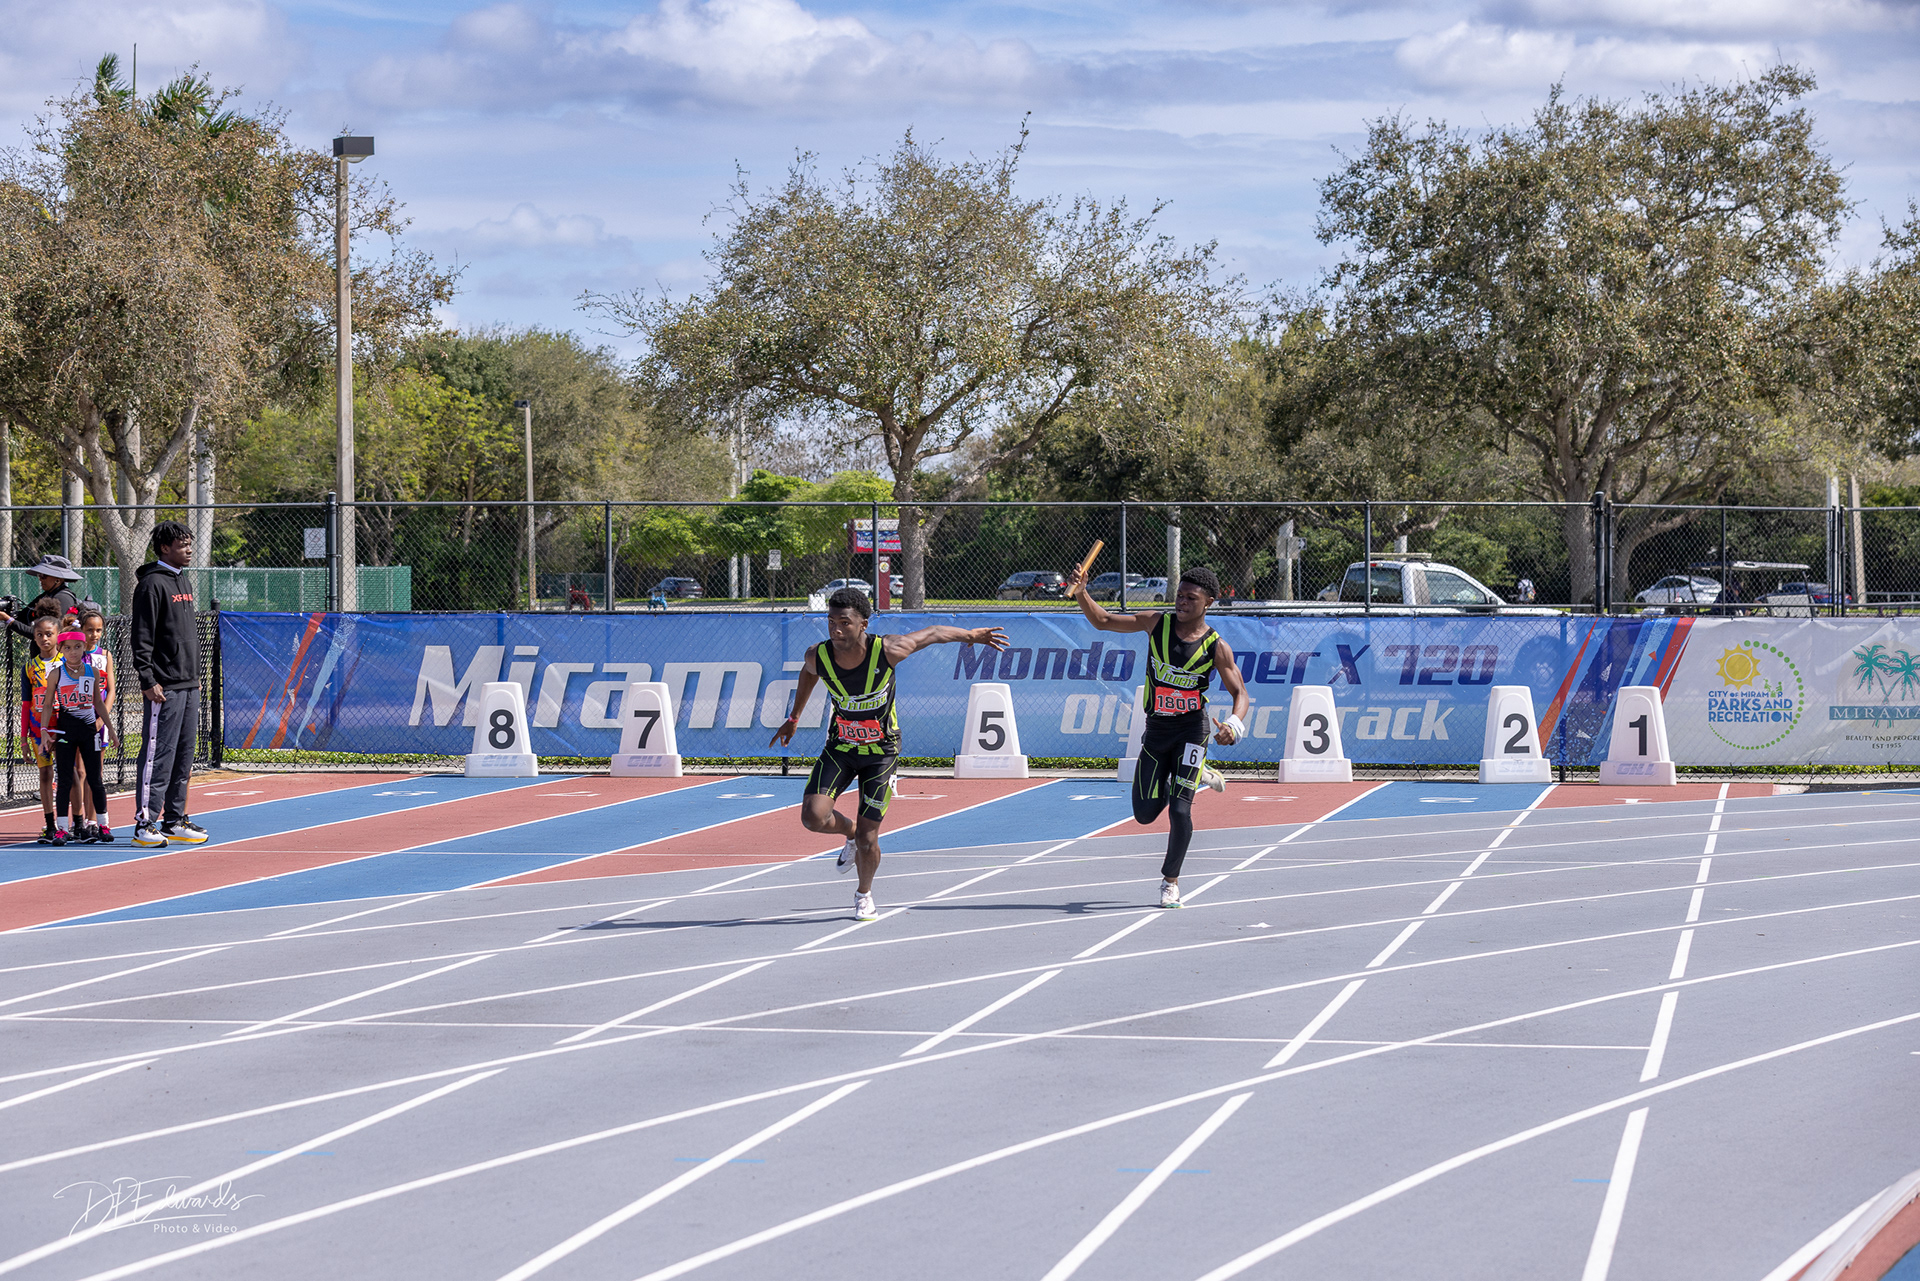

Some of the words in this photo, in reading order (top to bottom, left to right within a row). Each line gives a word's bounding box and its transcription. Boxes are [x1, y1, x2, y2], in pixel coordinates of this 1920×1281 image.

[953, 640, 1138, 682] Mondo
[1327, 644, 1371, 685] X
[1383, 644, 1499, 686] 720
[84, 680, 90, 693] 6
[408, 645, 830, 729] Mirama
[1708, 690, 1728, 698] CITY
[1740, 690, 1783, 698] MIRAMR
[1157, 694, 1198, 711] 1806
[1708, 698, 1761, 711] PARKS
[1763, 698, 1793, 709] AND
[1708, 711, 1793, 722] RECREATION
[488, 708, 515, 750] 8
[633, 710, 661, 749] 7
[839, 723, 881, 739] 1805
[978, 710, 1006, 751] 5
[1302, 712, 1331, 755] 3
[1334, 699, 1455, 741] rack
[1503, 713, 1530, 754] 2
[1628, 714, 1648, 756] 1
[627, 755, 663, 767] GILL
[1190, 749, 1198, 765] 6
[1616, 763, 1655, 775] GILL
